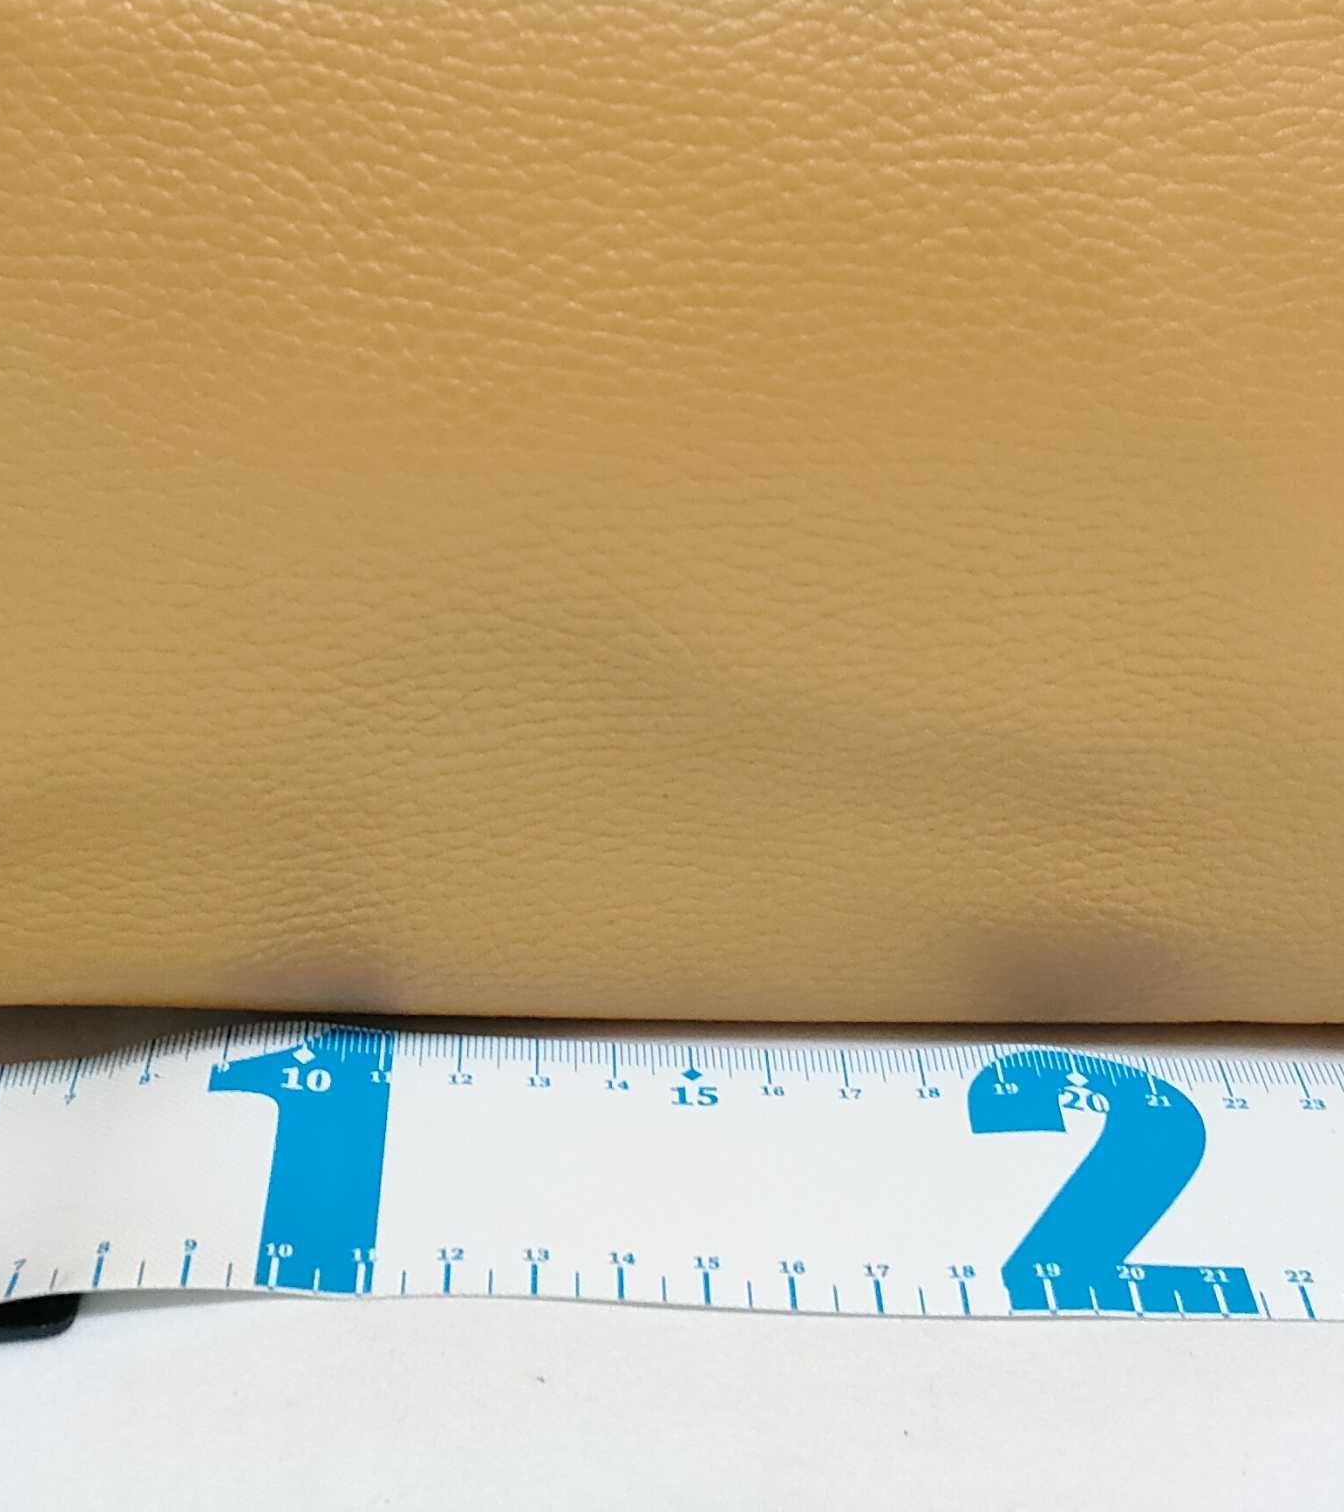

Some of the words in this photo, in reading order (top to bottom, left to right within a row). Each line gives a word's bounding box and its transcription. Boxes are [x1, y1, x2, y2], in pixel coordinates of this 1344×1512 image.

[280, 1068, 332, 1092] 10
[448, 1073, 473, 1086] 12
[529, 1076, 551, 1088] 13
[604, 1079, 629, 1091] 14
[671, 1086, 719, 1106] 15
[761, 1086, 785, 1097] 16
[838, 1088, 862, 1099] 17
[916, 1087, 941, 1099] 18
[994, 1084, 1018, 1095] 19
[1058, 1086, 1111, 1113] 20
[1145, 1095, 1171, 1107] 21
[1223, 1098, 1249, 1109] 22
[1300, 1098, 1326, 1109] 23
[208, 1023, 393, 1294] 1
[967, 1049, 1259, 1314] 2
[266, 1243, 293, 1257] 10
[437, 1248, 464, 1261] 12
[522, 1248, 549, 1261] 13
[609, 1252, 635, 1266] 14
[694, 1256, 720, 1269] 15
[779, 1260, 805, 1274] 16
[863, 1264, 890, 1277] 17
[948, 1265, 976, 1279] 18
[1032, 1264, 1061, 1278] 19
[1116, 1265, 1145, 1279] 20
[1201, 1269, 1230, 1282] 21
[1285, 1270, 1314, 1283] 22
